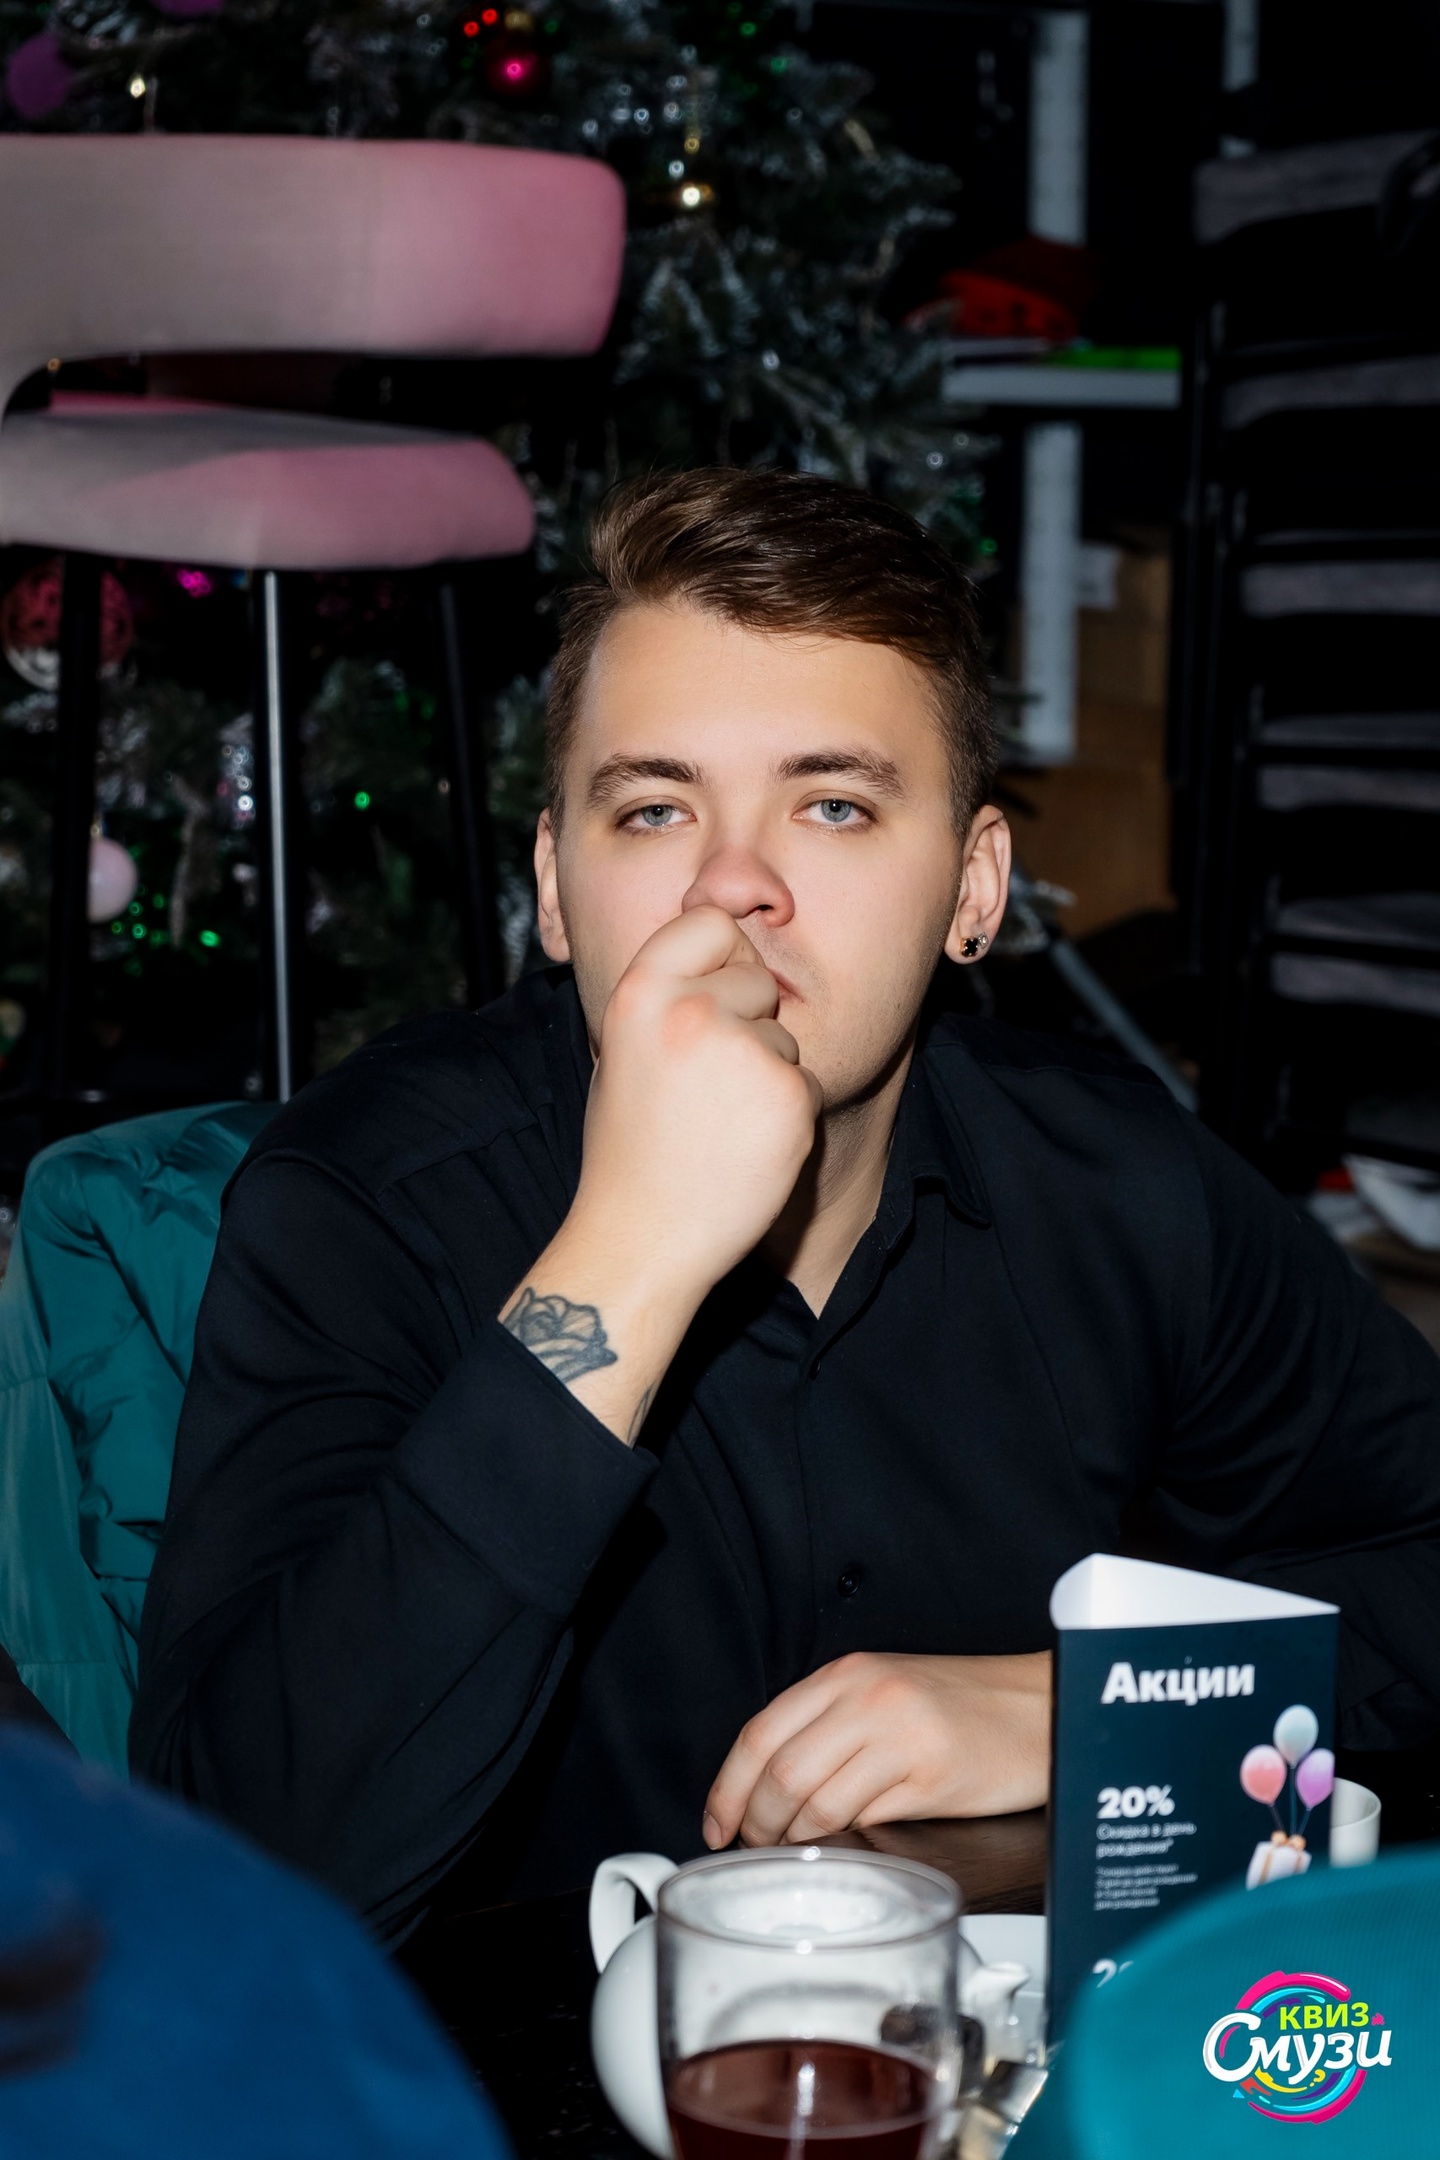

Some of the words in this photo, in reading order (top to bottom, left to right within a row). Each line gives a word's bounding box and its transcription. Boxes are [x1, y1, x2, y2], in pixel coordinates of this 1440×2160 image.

[1101, 1661, 1255, 1707] Акции
[1097, 1784, 1175, 1819] 20%
[1096, 1823, 1150, 1841] Скидка
